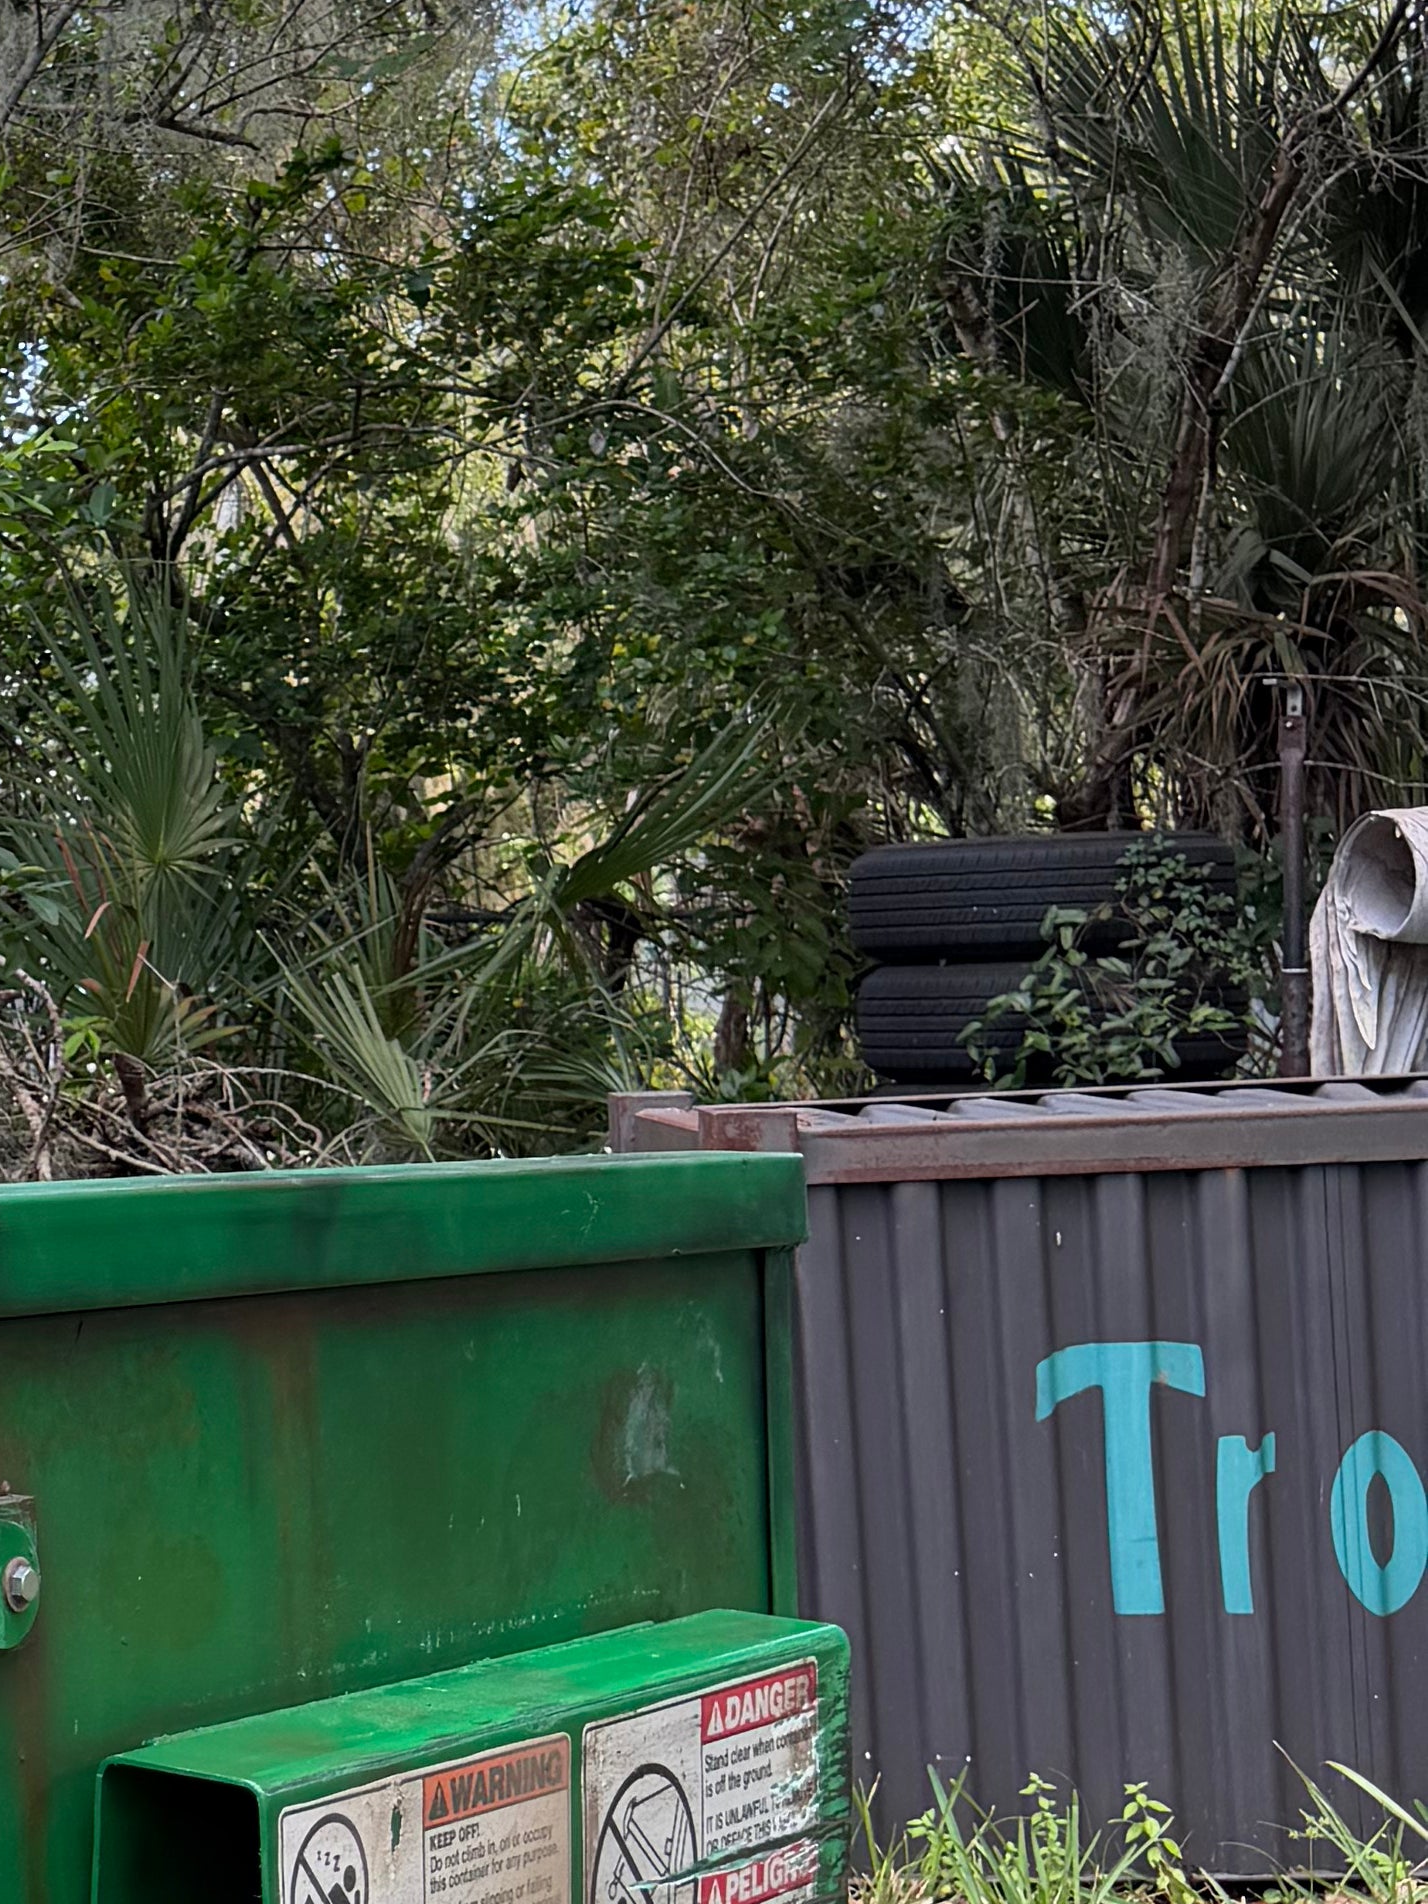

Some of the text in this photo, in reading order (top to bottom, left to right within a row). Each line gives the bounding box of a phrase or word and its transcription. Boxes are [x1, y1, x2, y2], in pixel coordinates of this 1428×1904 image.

[1035, 1341, 1428, 1616] Tro
[725, 1674, 810, 1730] DANGER
[704, 1748, 729, 1773] Stand
[730, 1744, 751, 1765] clear
[752, 1737, 775, 1757] when
[450, 1749, 562, 1815] WARNING
[705, 1758, 773, 1797] is off the ground.
[706, 1815, 714, 1835] IT
[715, 1811, 724, 1831] IS
[725, 1796, 770, 1827] UNLAWFUL
[429, 1822, 481, 1852] KEEP OFF!
[430, 1855, 443, 1874] Do
[444, 1849, 460, 1868] not
[461, 1842, 486, 1863] climb
[499, 1837, 511, 1849] on
[430, 1877, 446, 1894] this
[448, 1864, 489, 1889] container
[491, 1858, 503, 1875] for
[505, 1854, 521, 1872] any
[516, 1885, 525, 1899] or
